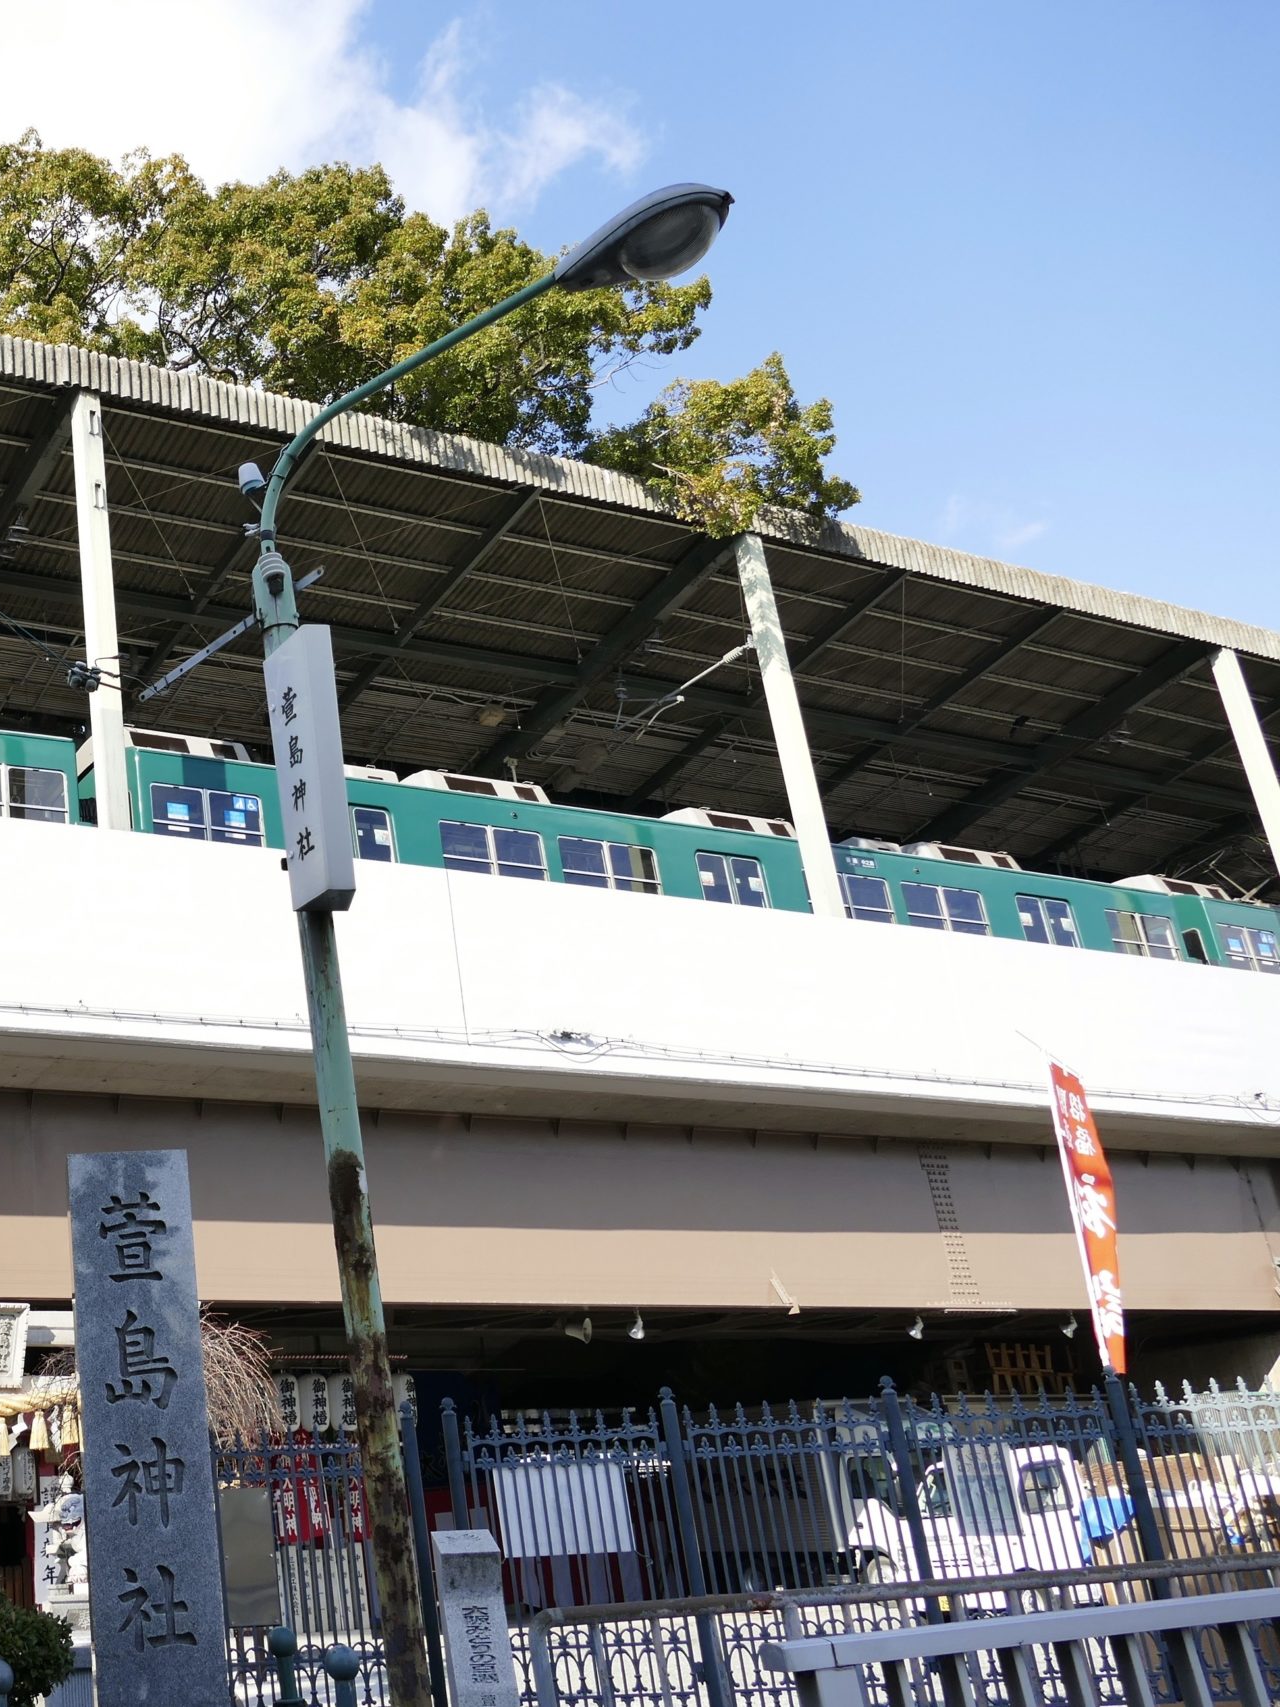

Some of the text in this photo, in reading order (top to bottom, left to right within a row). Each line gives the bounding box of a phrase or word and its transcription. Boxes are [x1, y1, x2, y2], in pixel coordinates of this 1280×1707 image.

[281, 686, 316, 861] 萱島神社
[99, 1191, 197, 1654] 萱島神社
